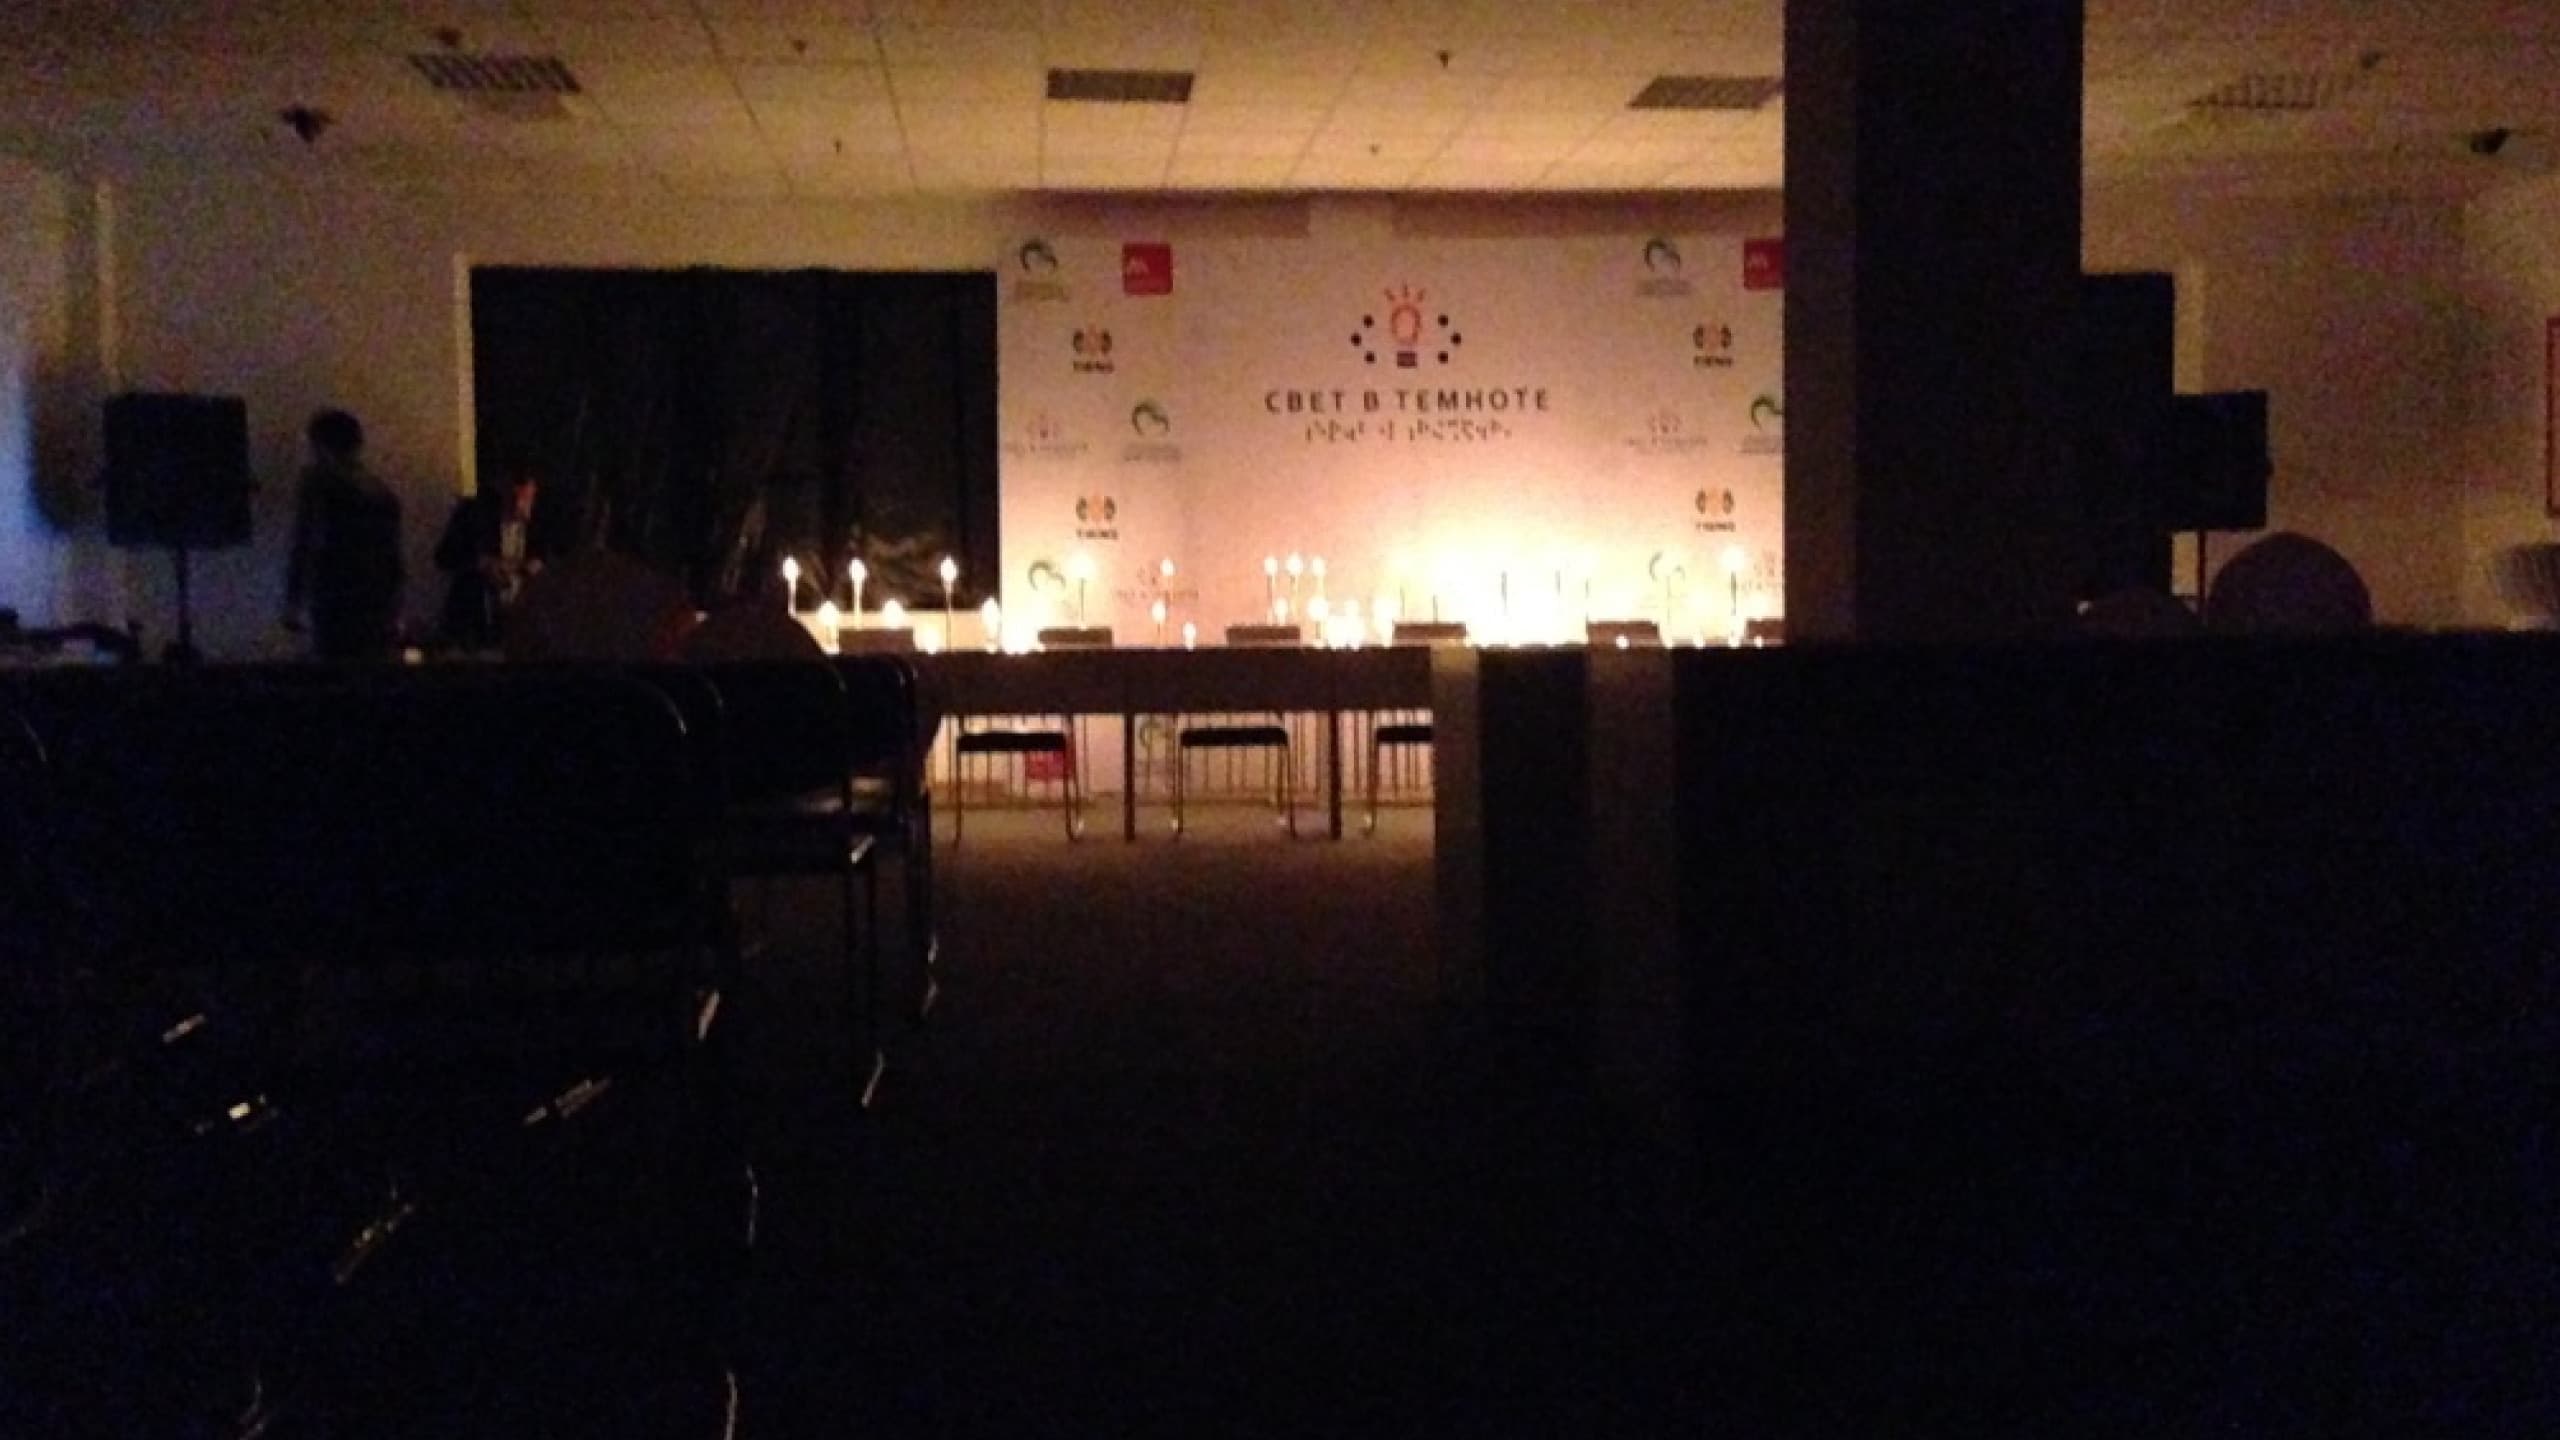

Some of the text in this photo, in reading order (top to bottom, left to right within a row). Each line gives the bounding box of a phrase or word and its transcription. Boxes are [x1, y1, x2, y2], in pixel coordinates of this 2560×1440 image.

[1264, 387, 1549, 413] СВЕТ В ТЕМНОТЕ
